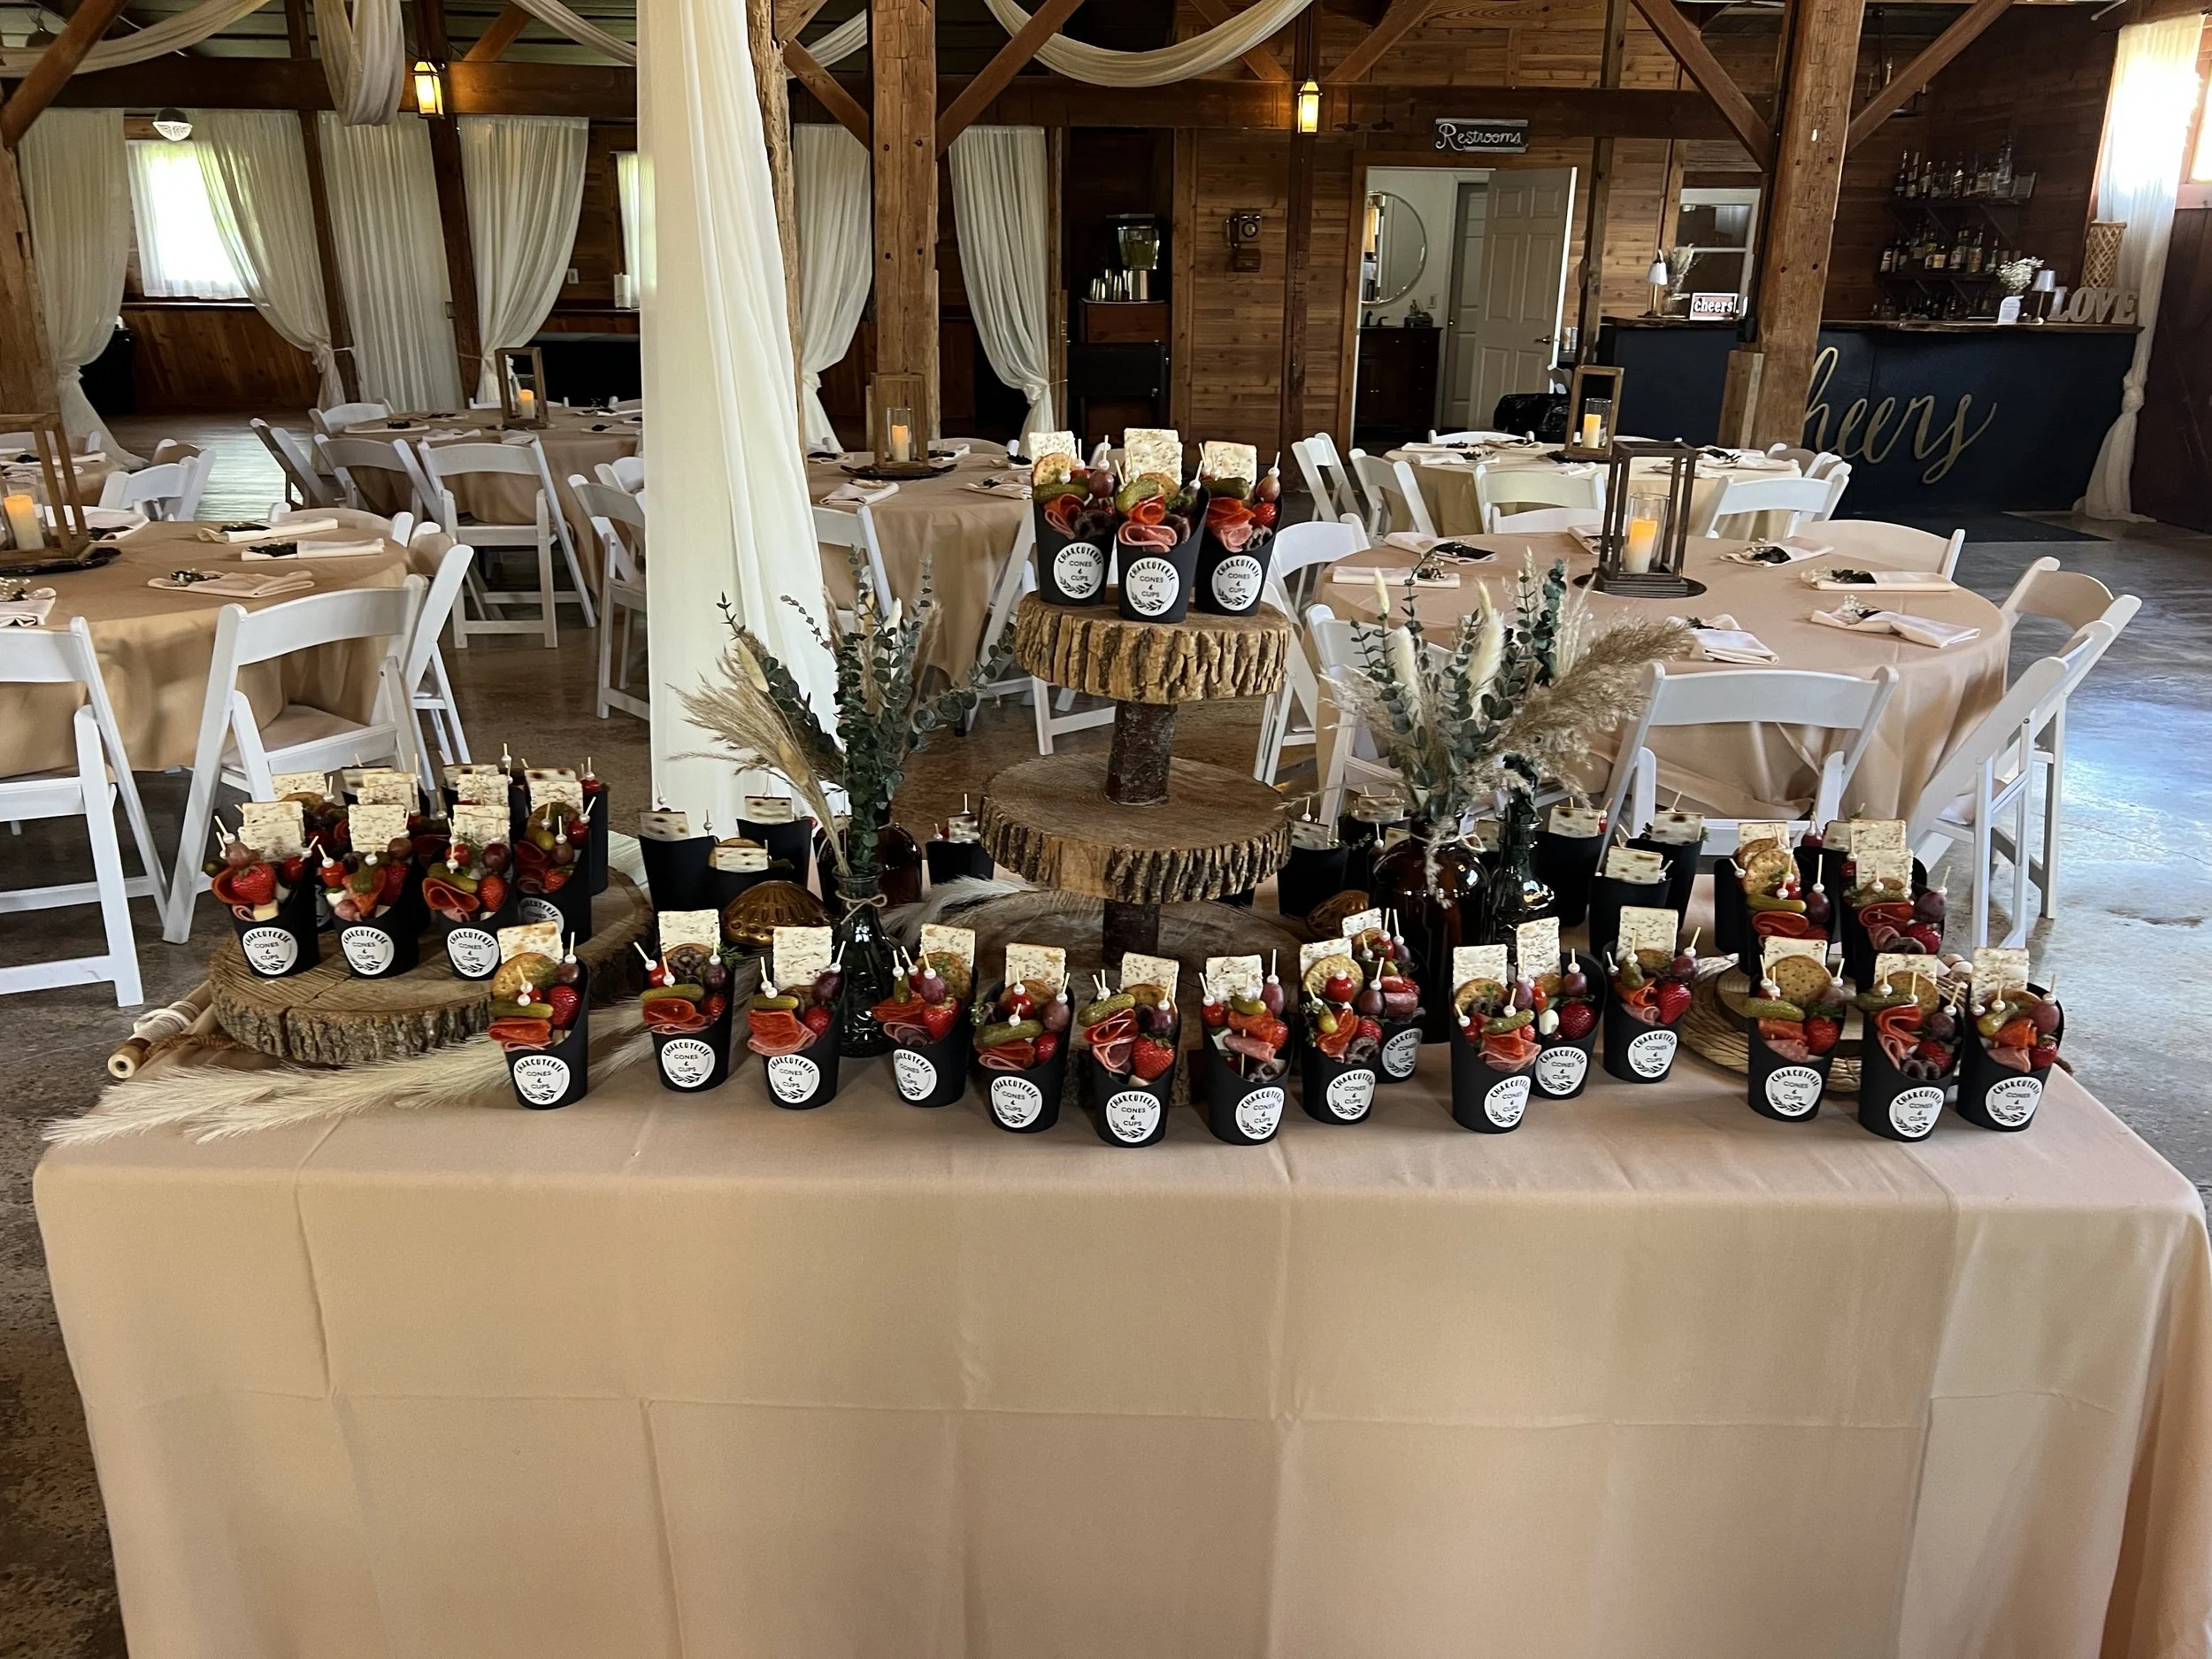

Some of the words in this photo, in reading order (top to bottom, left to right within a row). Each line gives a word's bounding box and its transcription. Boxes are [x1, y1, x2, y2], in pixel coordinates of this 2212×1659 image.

[1435, 123, 1529, 151] Restrooms
[2047, 286, 2139, 325] LOVE
[1801, 346, 1997, 484] heers
[1057, 546, 1102, 566] CHARCUTERIE
[1129, 561, 1176, 581] CHARCUTERIE
[1217, 558, 1260, 577] CHARCUTERIE
[664, 1042, 710, 1056] CHARCUTERIE
[516, 1058, 565, 1073] CHARCUTERIE
[1110, 1094, 1156, 1110] CHARCUTERIE
